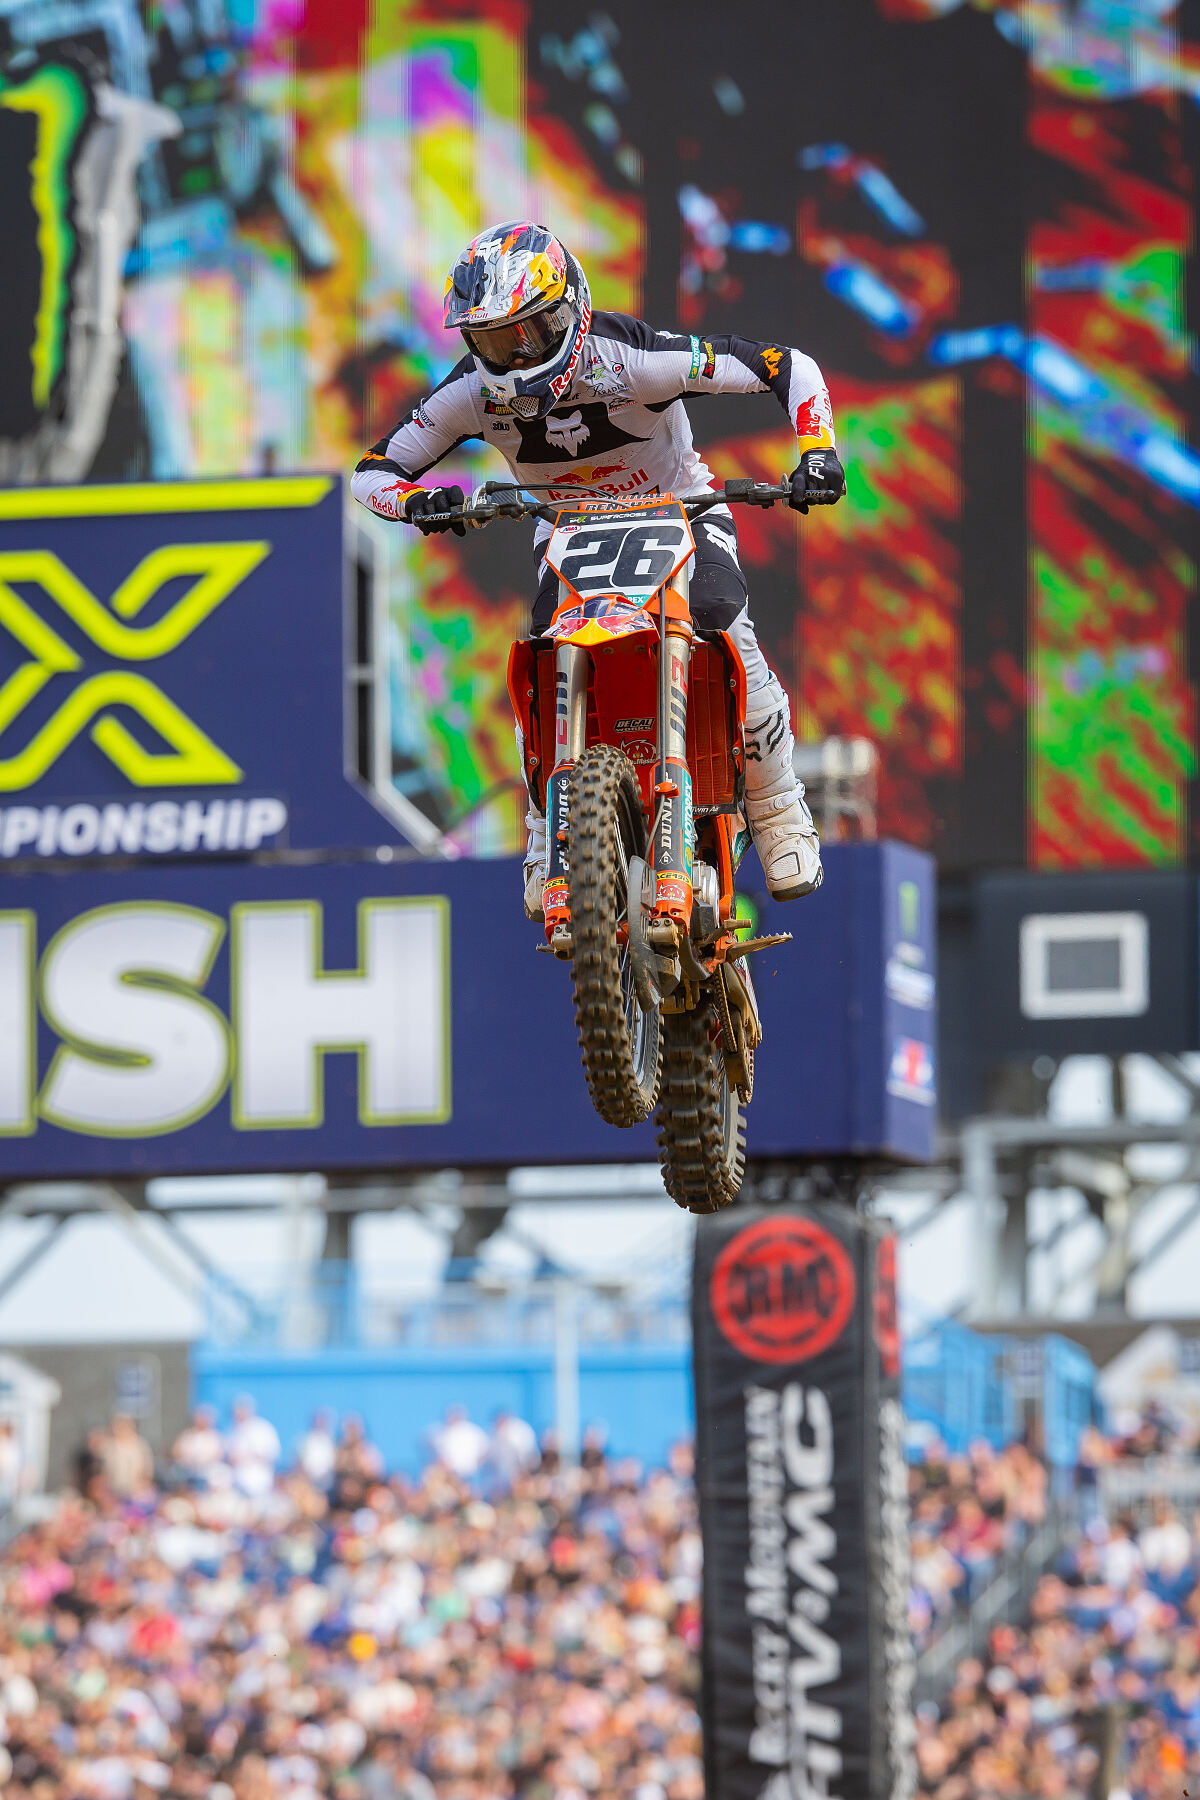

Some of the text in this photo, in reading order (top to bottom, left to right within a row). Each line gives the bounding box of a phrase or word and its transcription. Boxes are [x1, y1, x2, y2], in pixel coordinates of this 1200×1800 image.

[808, 454, 826, 480] FOX
[598, 468, 649, 497] Bull
[590, 512, 647, 522] SUPERCROSS
[560, 525, 685, 592] 26
[617, 719, 653, 729] DECAL
